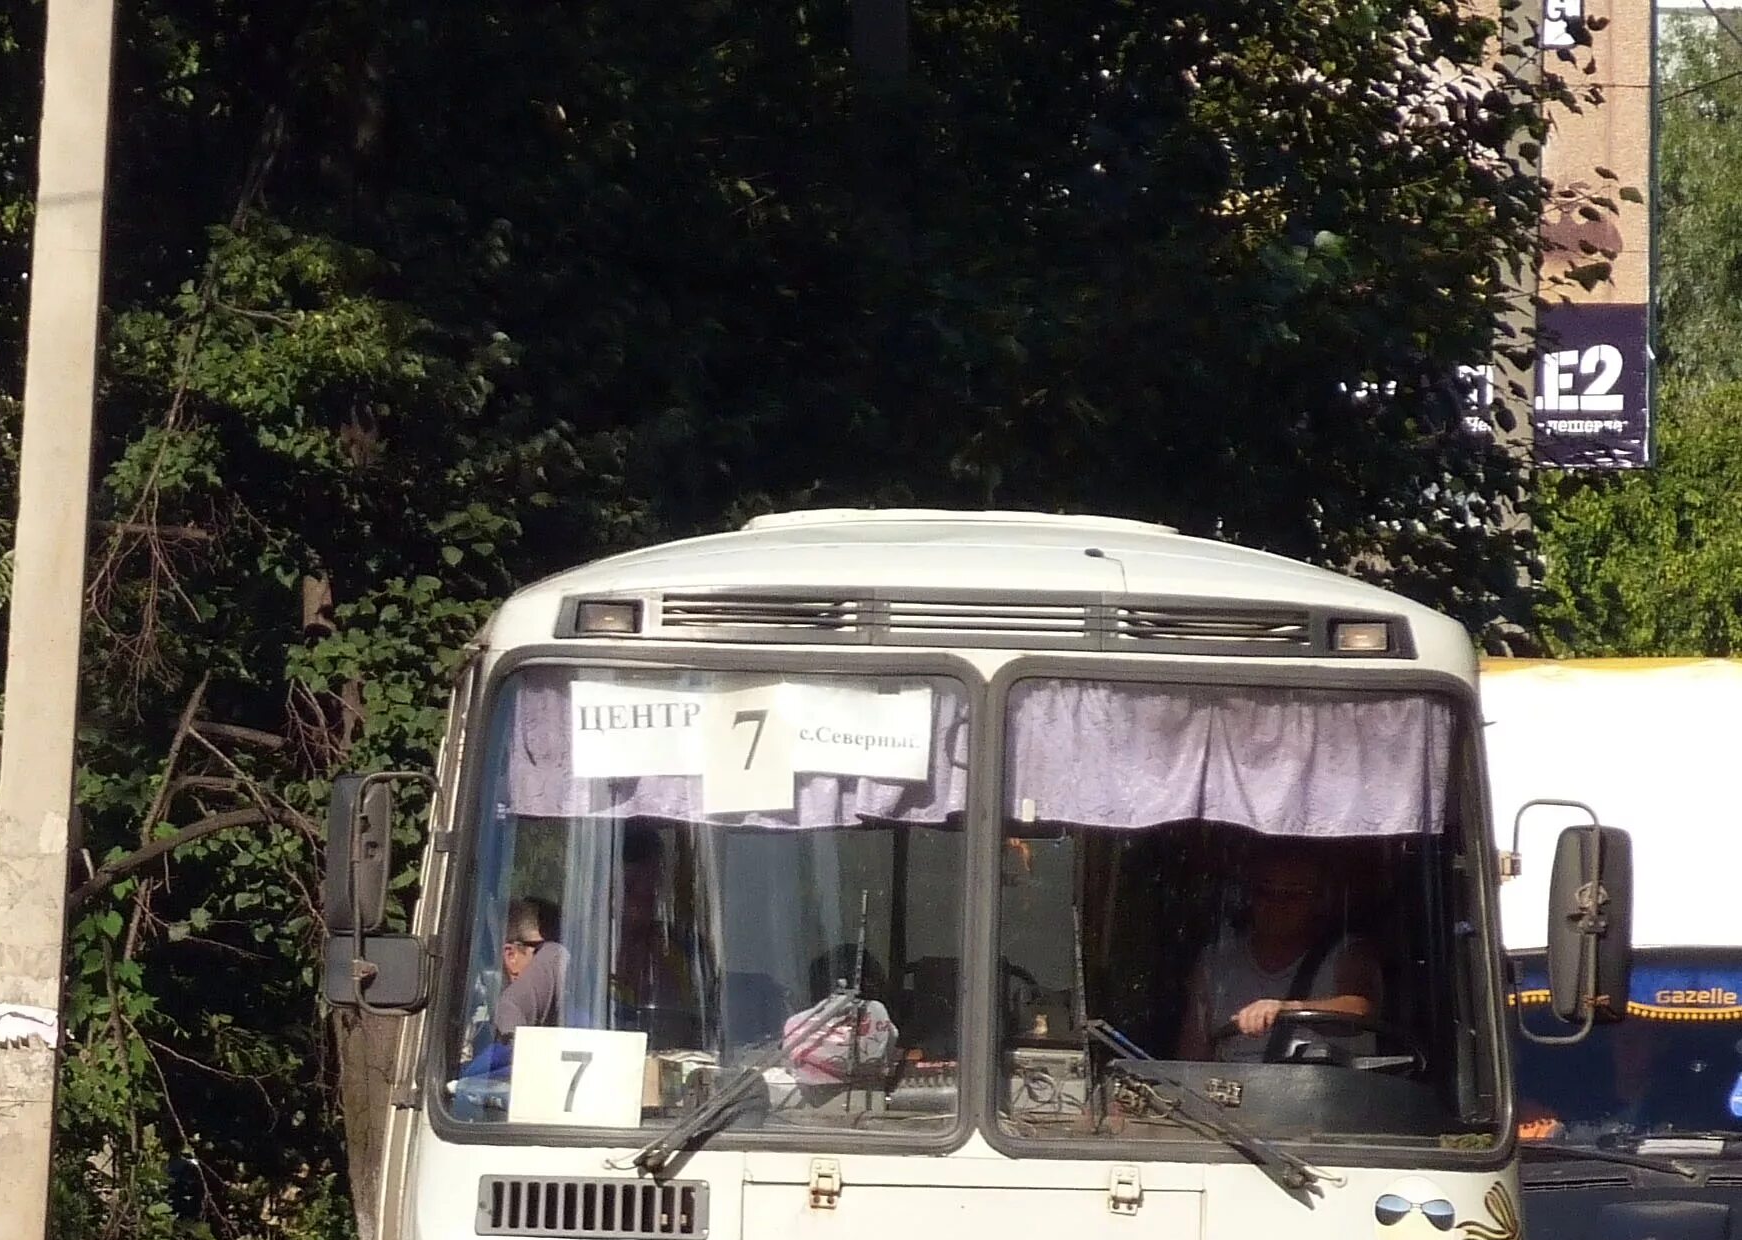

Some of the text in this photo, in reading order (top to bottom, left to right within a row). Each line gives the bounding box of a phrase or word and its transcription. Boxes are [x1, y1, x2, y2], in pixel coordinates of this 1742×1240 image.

[579, 703, 701, 735] ЦЕНТР
[731, 709, 769, 770] 7
[561, 1050, 593, 1112] 7
